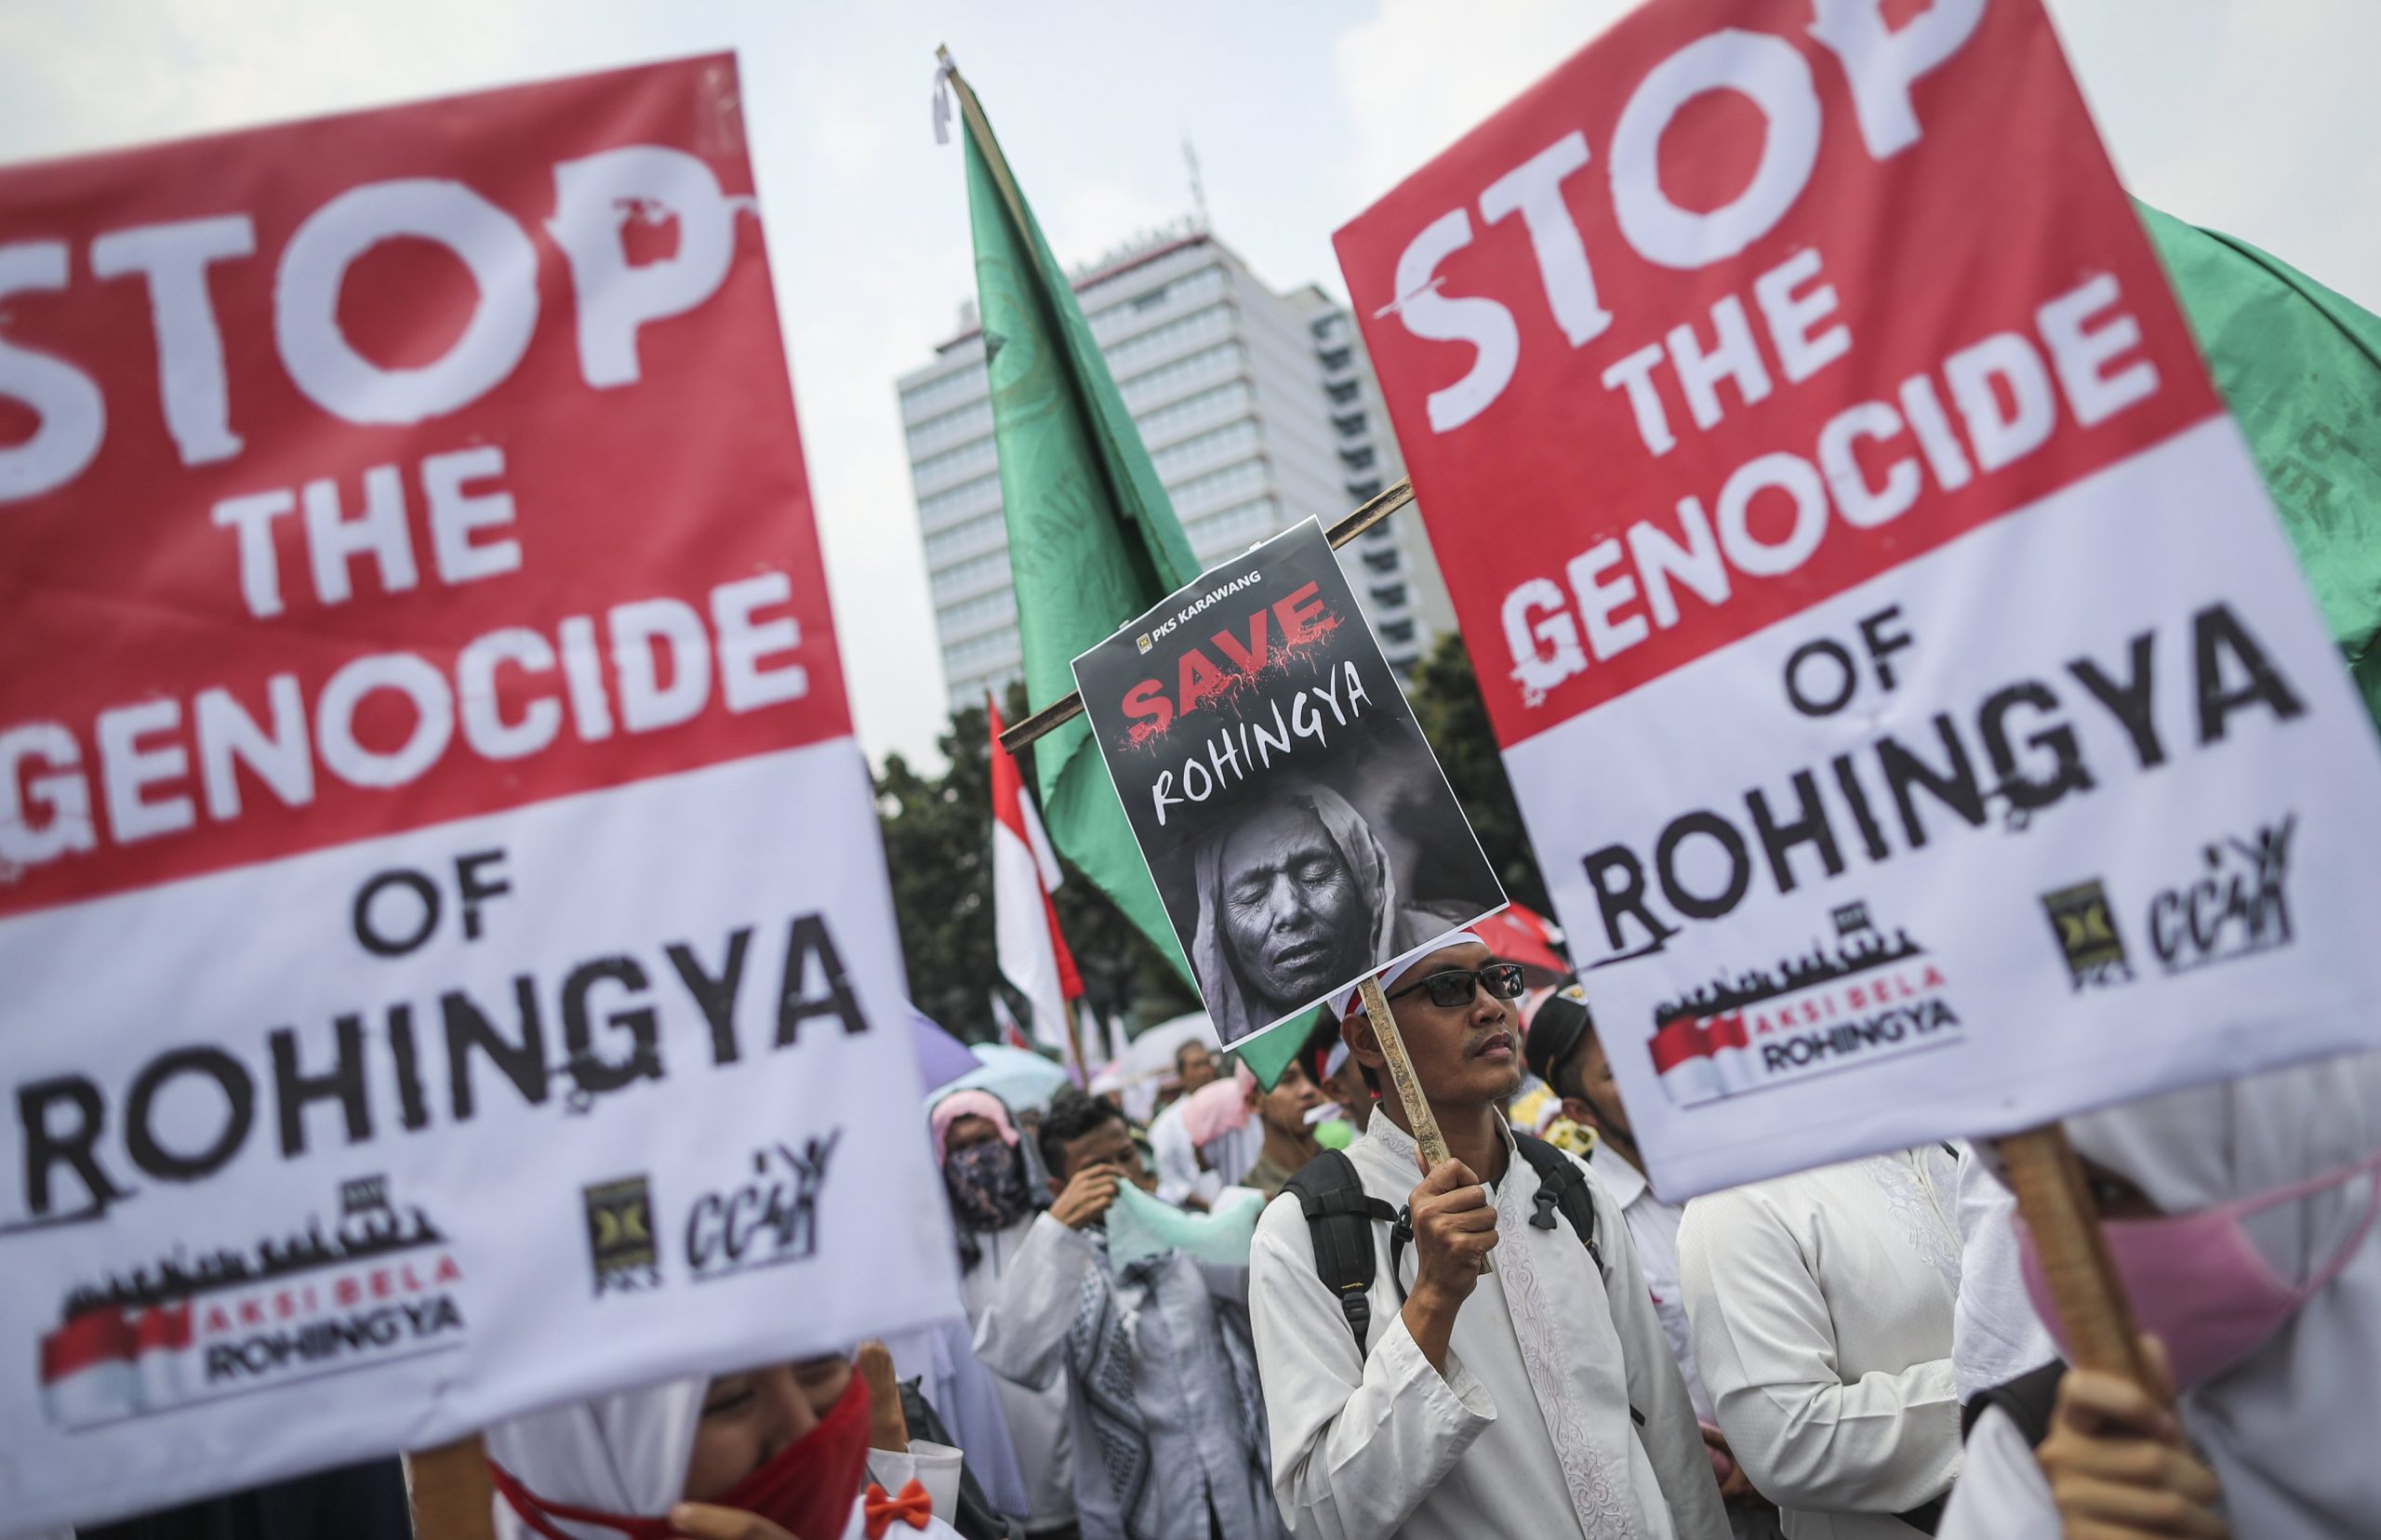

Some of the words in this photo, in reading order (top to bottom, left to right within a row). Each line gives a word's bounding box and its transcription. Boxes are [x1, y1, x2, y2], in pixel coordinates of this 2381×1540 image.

[0, 145, 752, 501] STOP
[1602, 248, 1852, 457] THE
[212, 445, 522, 617] THE
[1501, 274, 2158, 708] GENOCIDE
[1120, 580, 1344, 751] SAVE
[1151, 617, 1177, 642] PKS
[1177, 570, 1262, 624] KARAWANG
[1784, 605, 1912, 718] OF
[0, 570, 807, 863] GENOCIDE
[1151, 660, 1373, 827] ROHINGYA
[1578, 604, 2305, 967] ROHINGYA
[352, 850, 511, 958] OF
[2, 913, 870, 1233] ROHINGYA
[1756, 996, 1836, 1035] AKSI
[1846, 965, 1948, 1011] BELA
[1761, 998, 1962, 1073] ROHINGYA
[205, 1285, 317, 1334] AKSI
[335, 1255, 461, 1307] BELA
[205, 1294, 465, 1383] ROHINGYA
